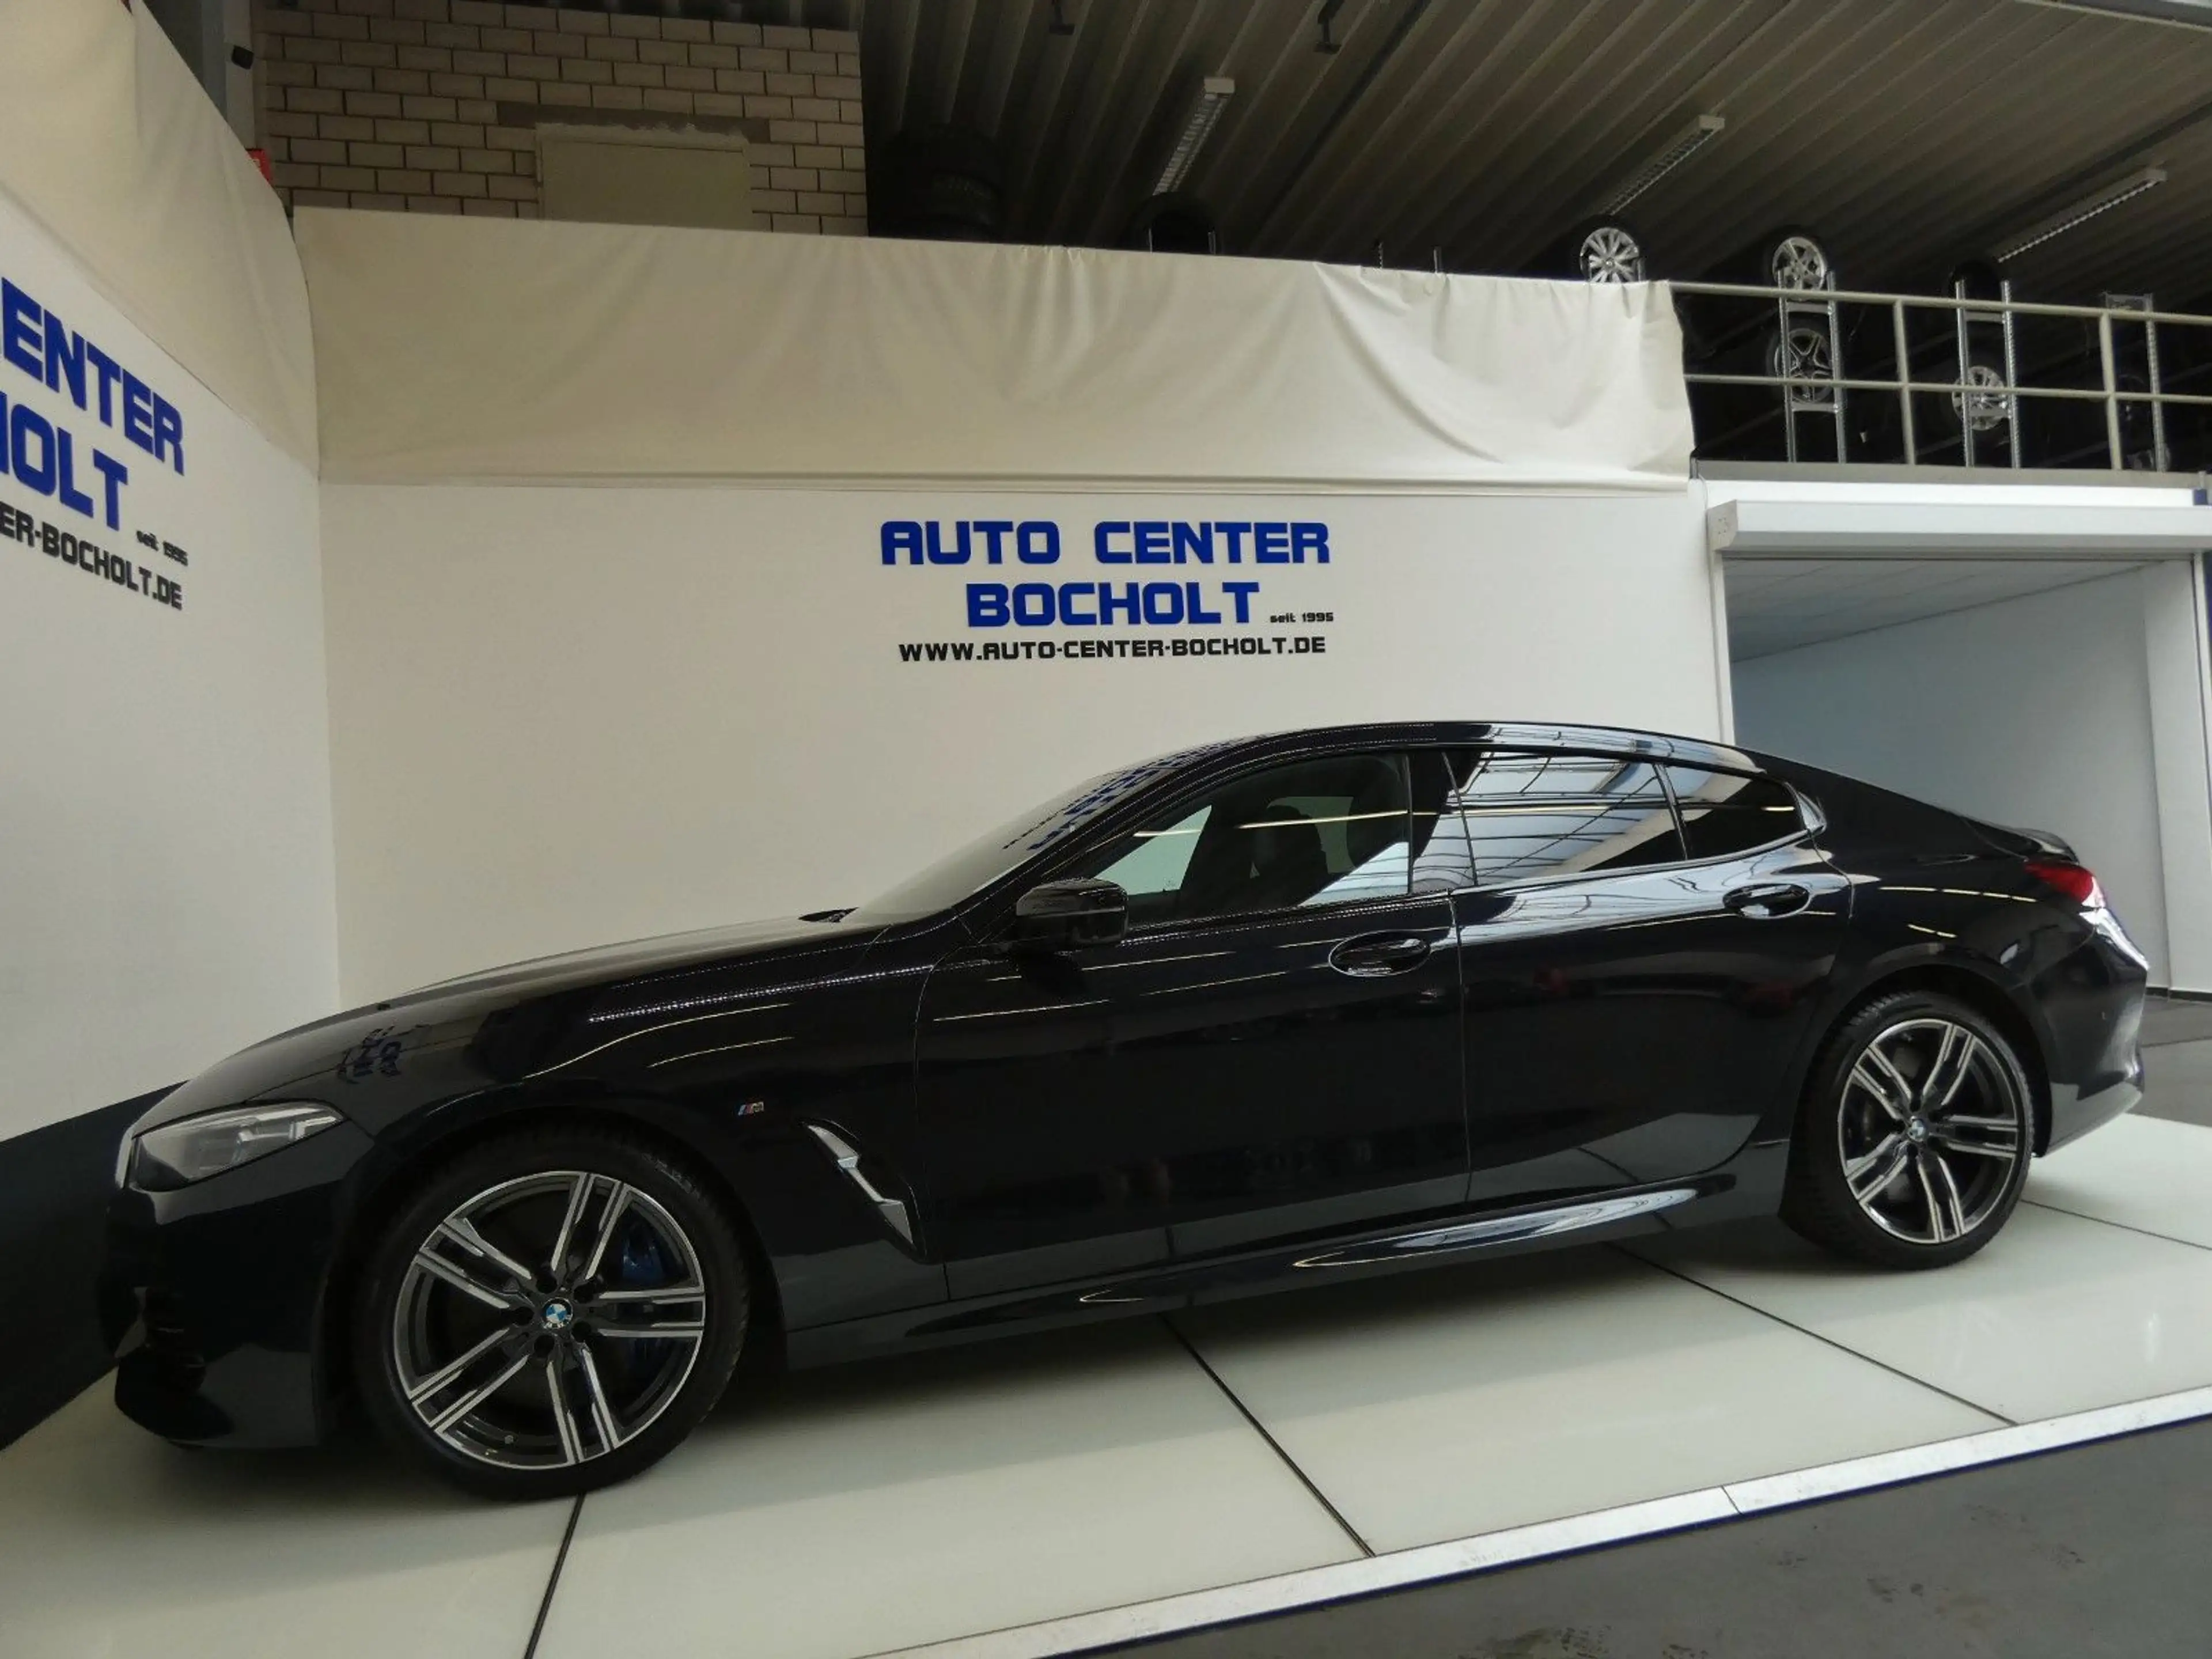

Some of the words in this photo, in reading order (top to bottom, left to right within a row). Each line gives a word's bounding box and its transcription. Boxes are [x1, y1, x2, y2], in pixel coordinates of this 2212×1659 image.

[1, 276, 184, 476] ENTER
[0, 391, 128, 531] OLT
[881, 521, 1060, 565] AUTO
[1094, 521, 1330, 564] CENTER
[966, 582, 1259, 627] BOCHOLT
[1270, 612, 1296, 623] seit
[1302, 612, 1334, 622] 1995
[899, 637, 1325, 662] WWW.AUTO-CENTER-BOCHOLT.DE
